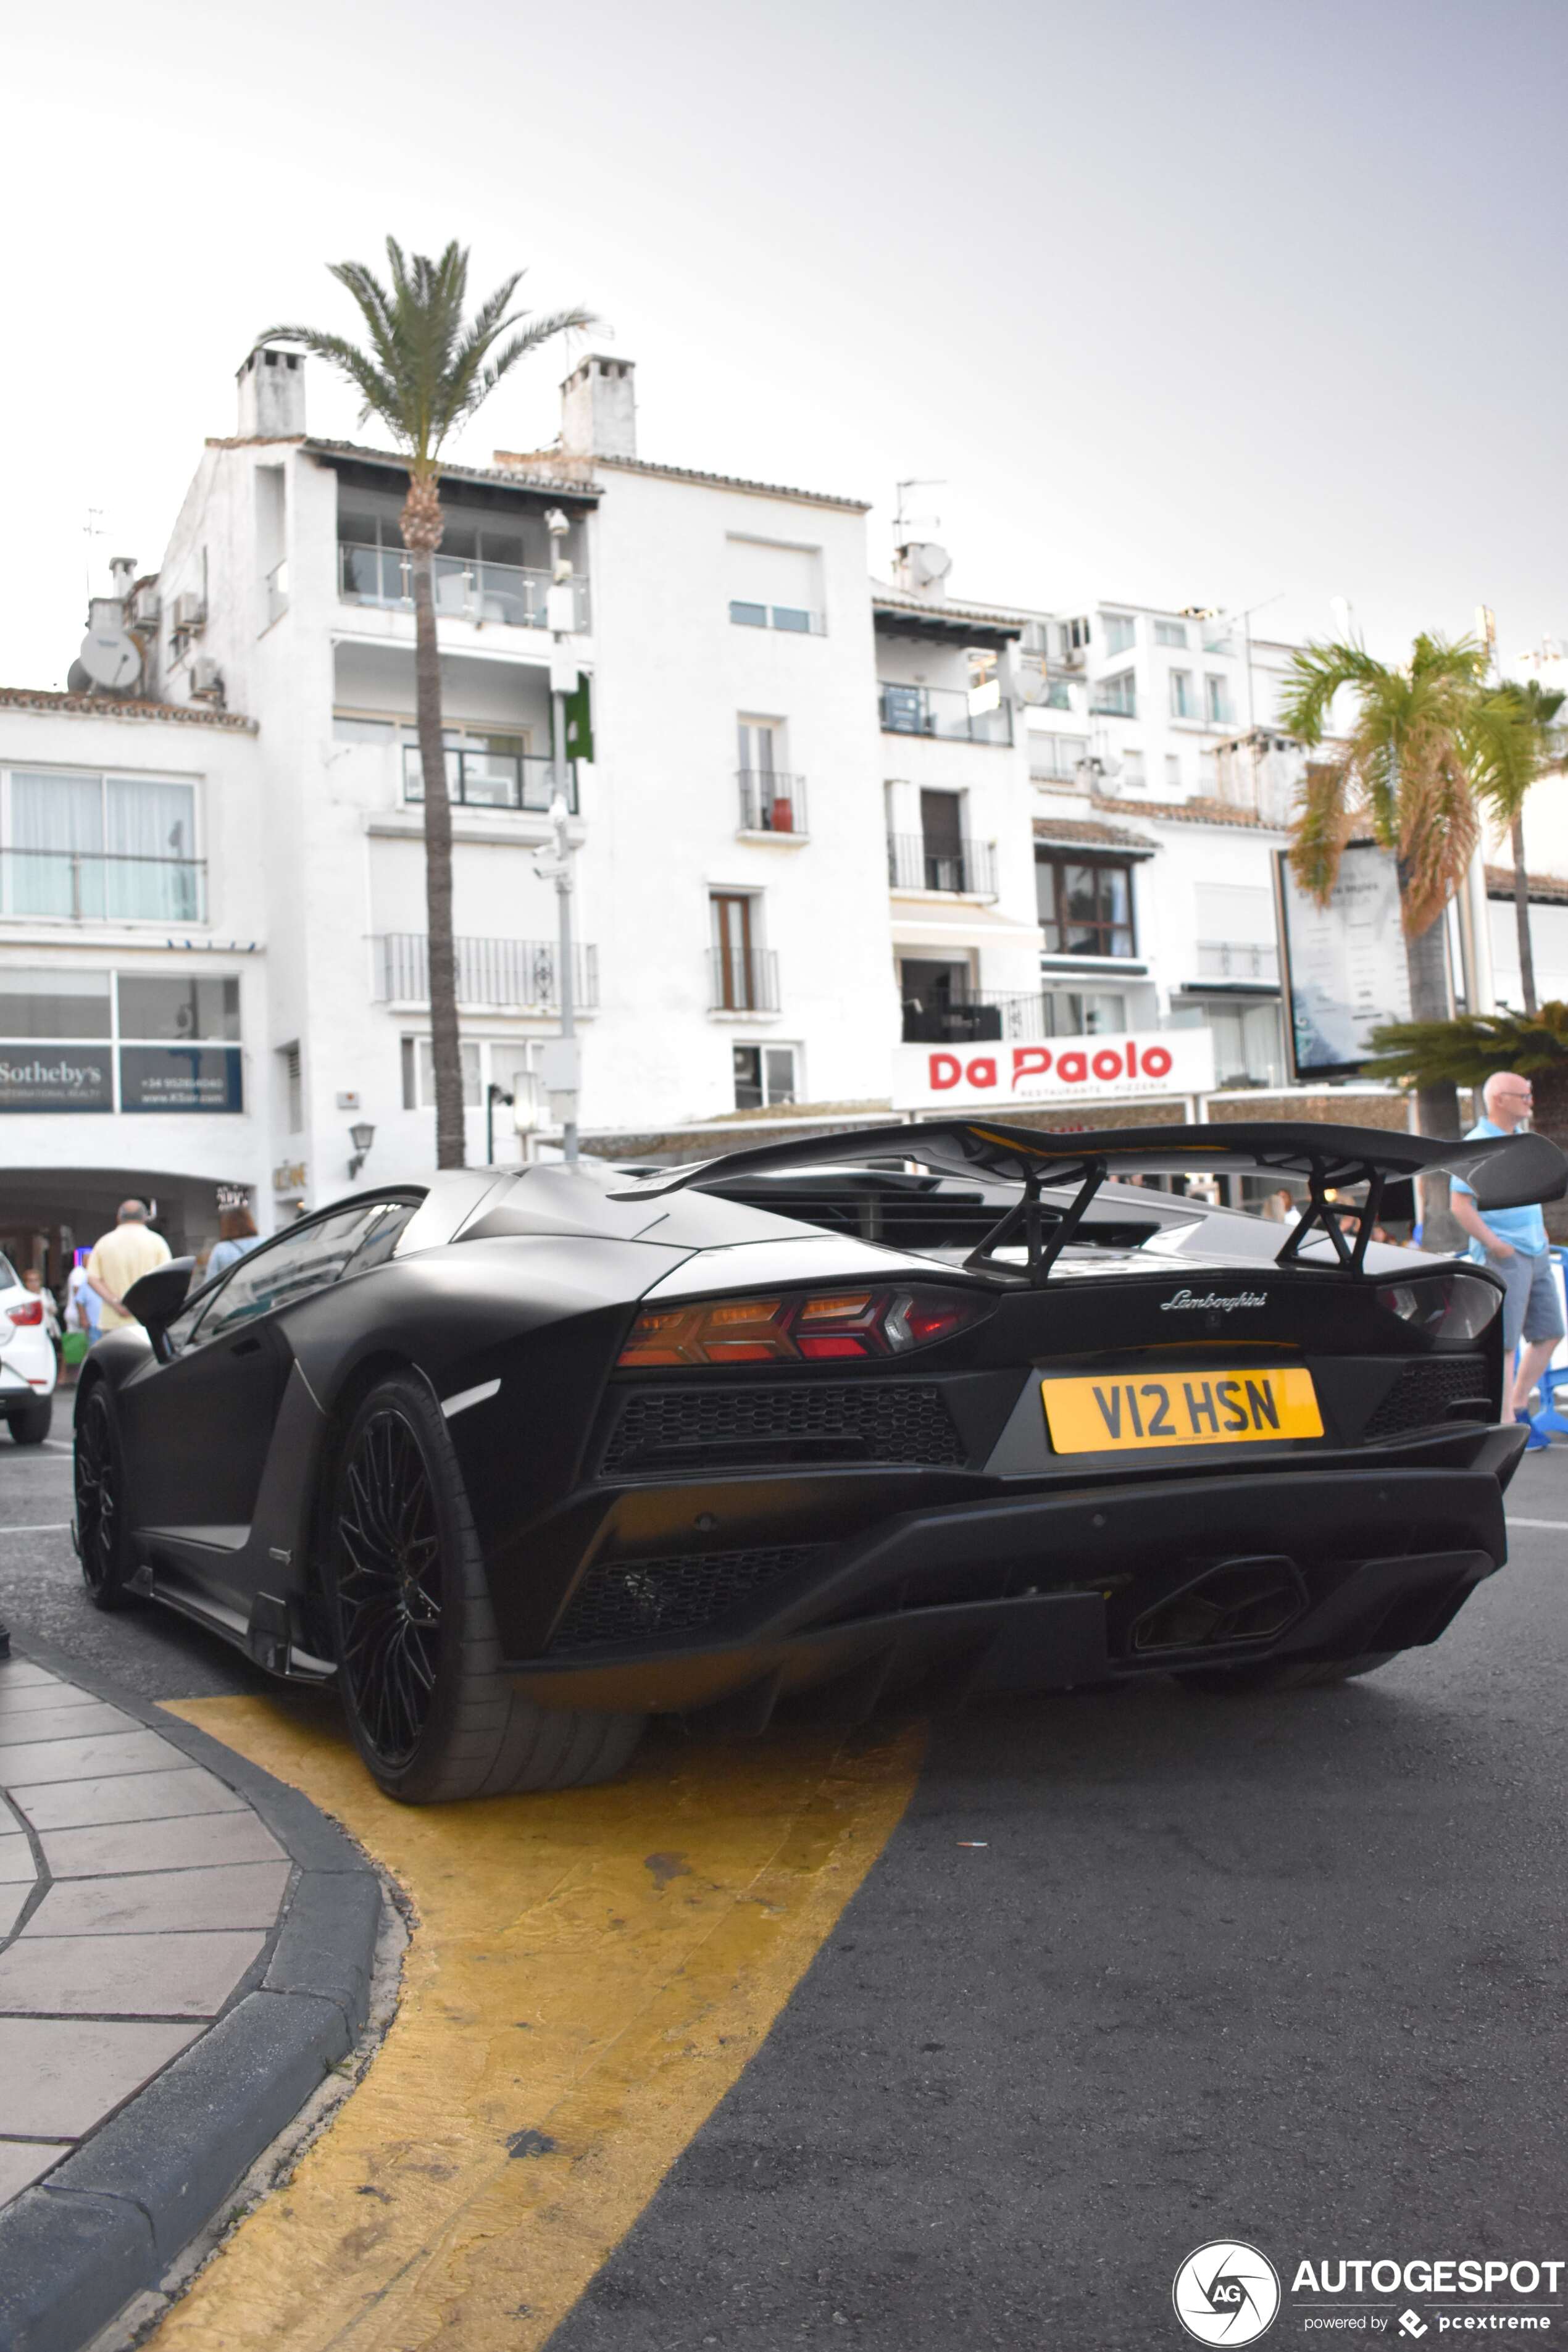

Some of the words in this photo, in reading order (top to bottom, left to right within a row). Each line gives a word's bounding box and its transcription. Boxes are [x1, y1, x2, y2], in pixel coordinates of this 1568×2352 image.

[0, 1061, 101, 1088] Sotheby's
[928, 1053, 997, 1090] Da
[1011, 1040, 1173, 1092] Paolo
[1020, 1084, 1102, 1098] RESTAURANTE
[1114, 1082, 1167, 1092] PIZZERIA
[1160, 1289, 1267, 1312] Lamborghini
[1091, 1383, 1177, 1439] V12
[1182, 1379, 1280, 1433] HSN
